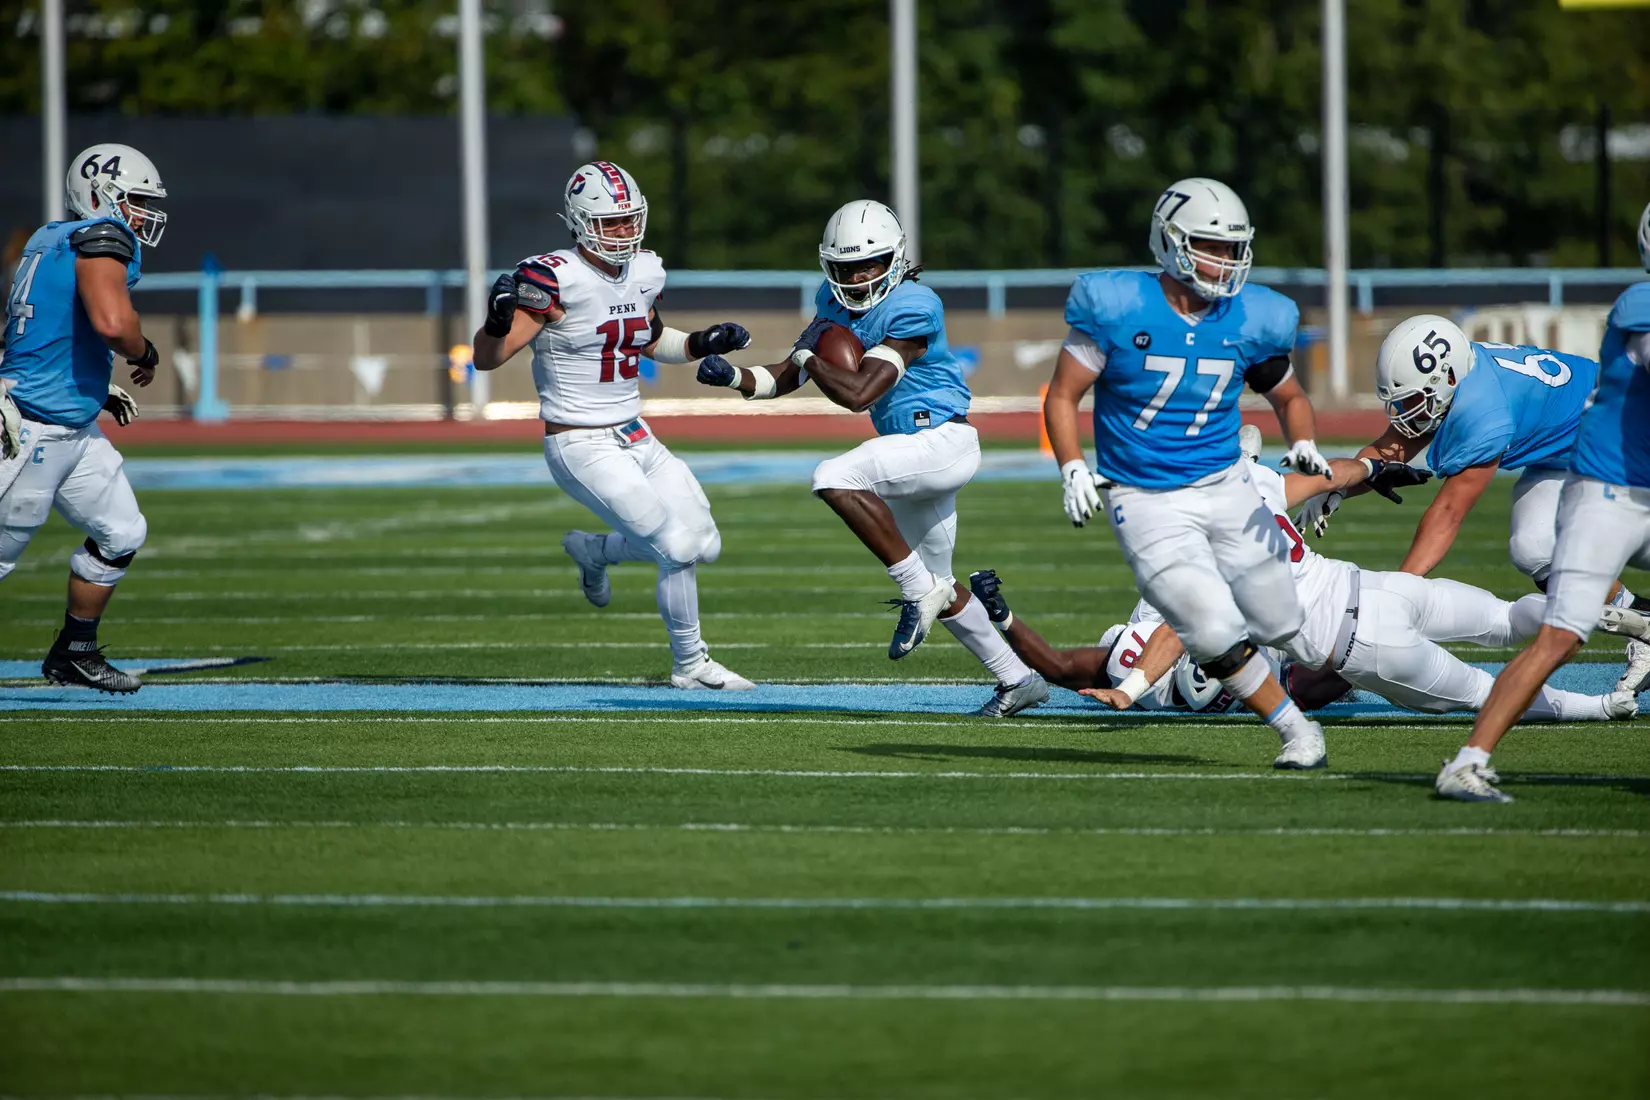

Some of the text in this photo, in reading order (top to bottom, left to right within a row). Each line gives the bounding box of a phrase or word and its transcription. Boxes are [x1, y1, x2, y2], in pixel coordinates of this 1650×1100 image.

[80, 154, 121, 180] 64
[1156, 190, 1192, 221] 77
[1228, 224, 1246, 232] LIONS
[839, 246, 861, 254] LIONS
[6, 252, 42, 335] 4
[609, 303, 637, 315] PENN
[596, 316, 649, 384] 15
[1185, 332, 1195, 346] C
[1412, 330, 1452, 375] 65
[1132, 354, 1236, 437] 77
[32, 446, 45, 465] C
[1113, 504, 1126, 526] C
